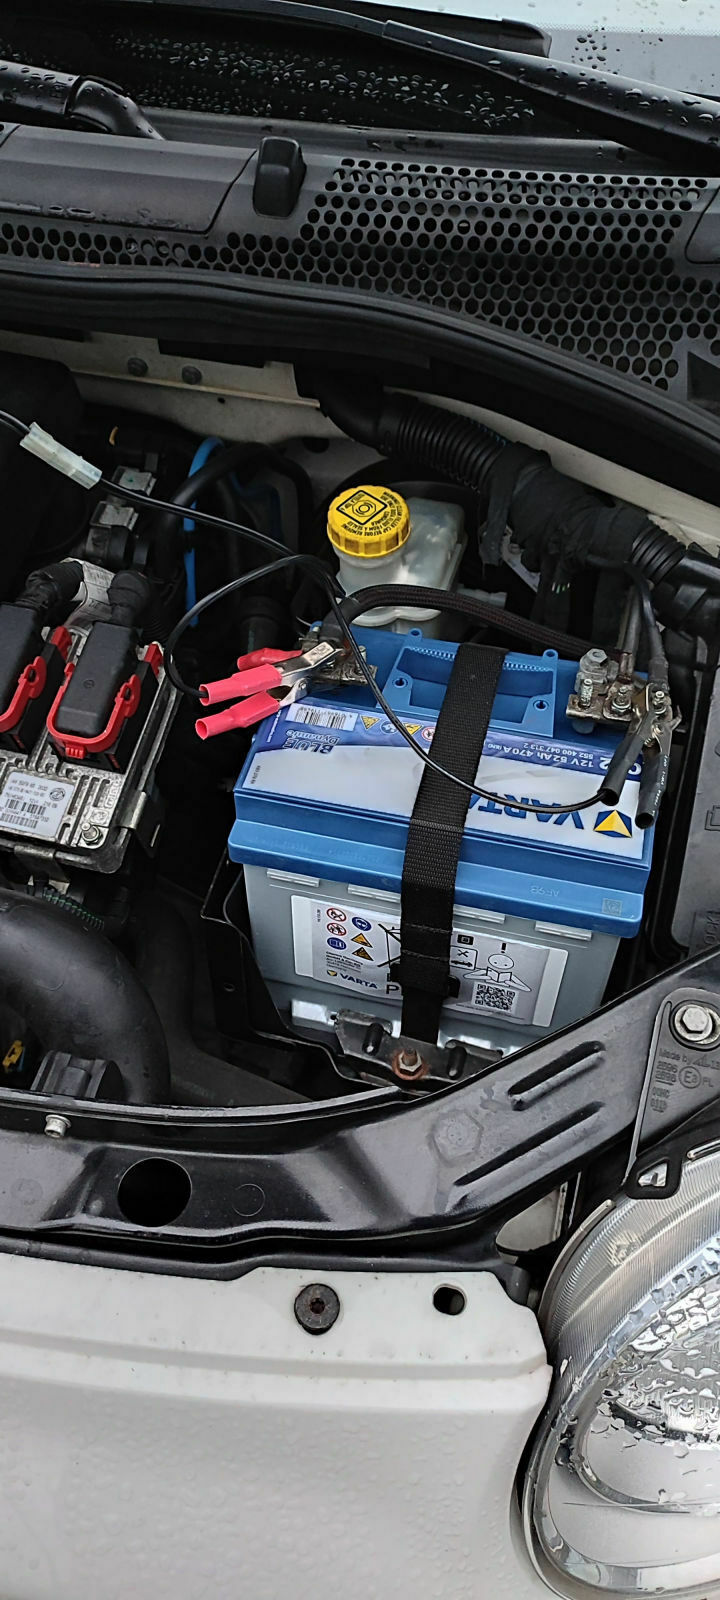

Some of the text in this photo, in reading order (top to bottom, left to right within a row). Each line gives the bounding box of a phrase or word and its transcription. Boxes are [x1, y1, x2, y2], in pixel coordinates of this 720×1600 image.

[286, 729, 340, 745] Dynamic
[282, 738, 335, 754] BLUE
[503, 746, 534, 758] 470A
[537, 752, 567, 764] 52Ah
[571, 757, 594, 768] 12V
[600, 757, 642, 775] C2
[340, 973, 378, 989] VARTA
